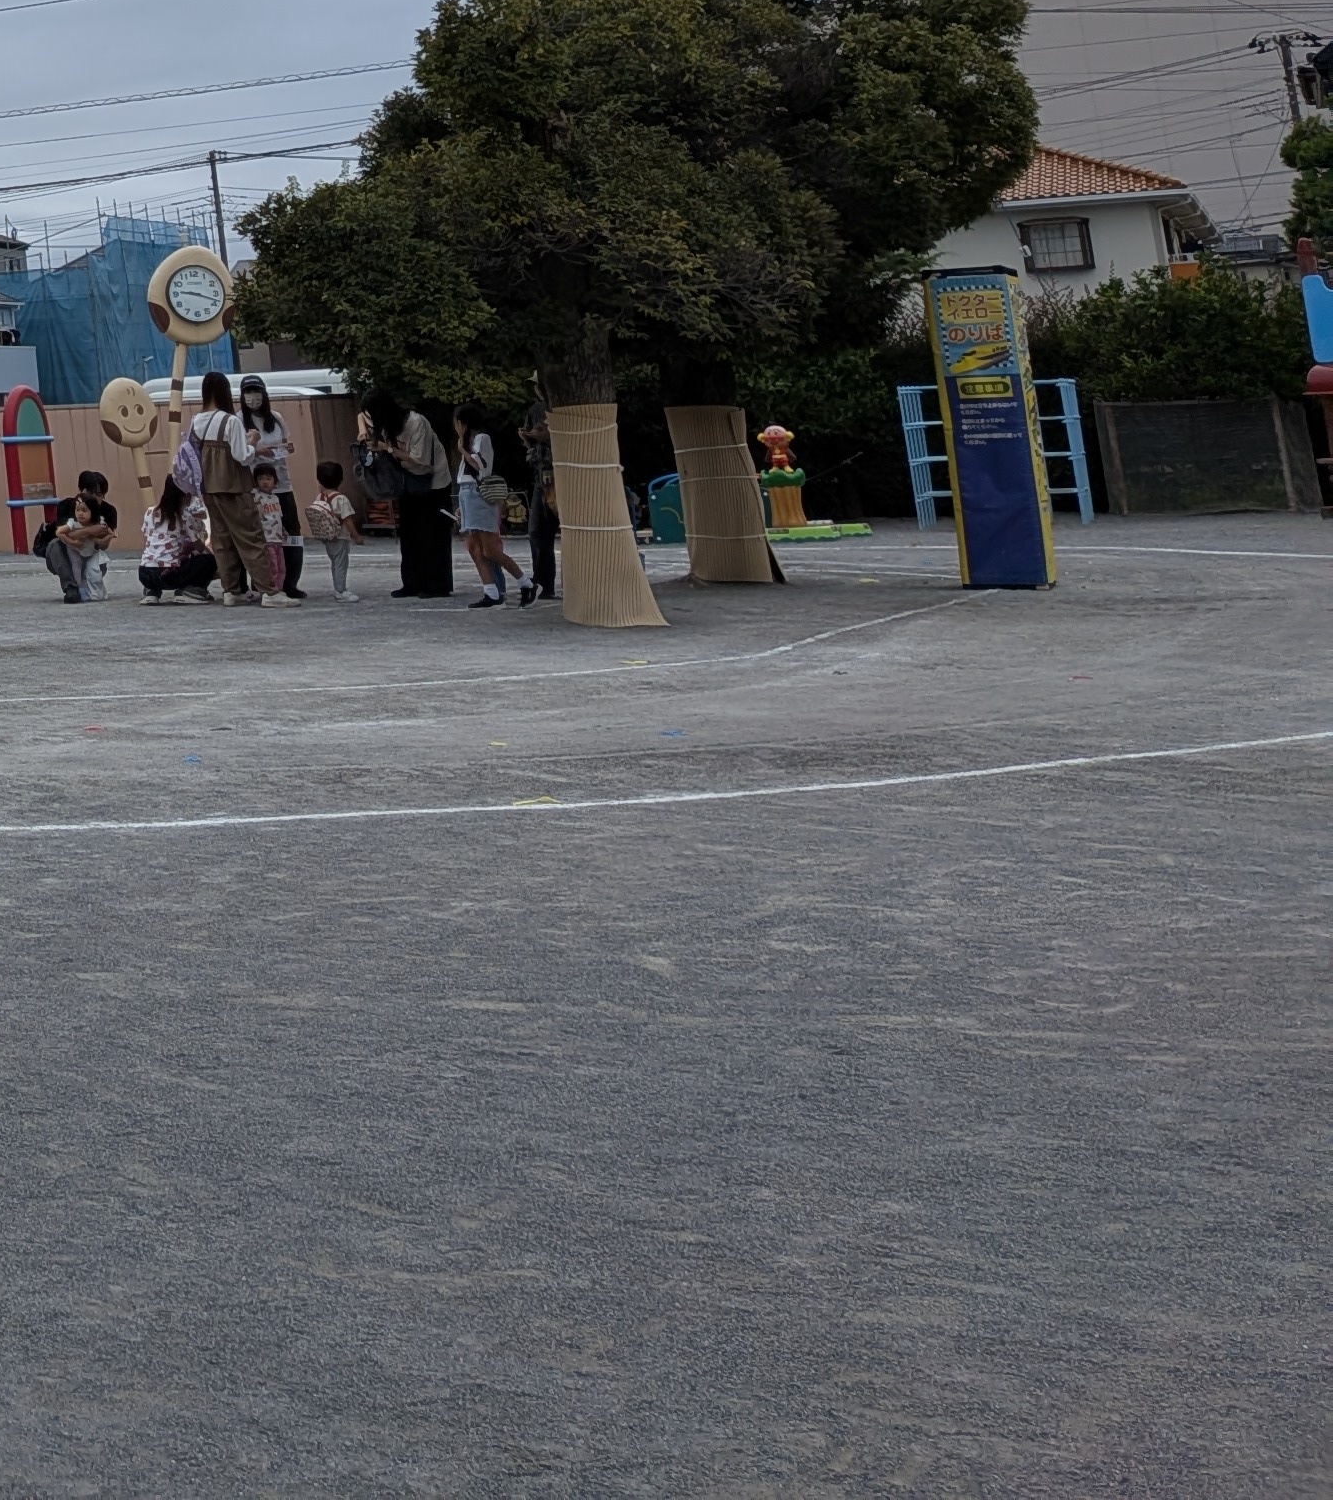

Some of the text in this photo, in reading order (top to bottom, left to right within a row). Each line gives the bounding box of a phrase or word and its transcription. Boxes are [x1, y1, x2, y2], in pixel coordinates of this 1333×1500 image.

[946, 293, 1000, 307] ドクター
[946, 307, 1002, 320] イエロー
[947, 322, 1004, 343] のりば
